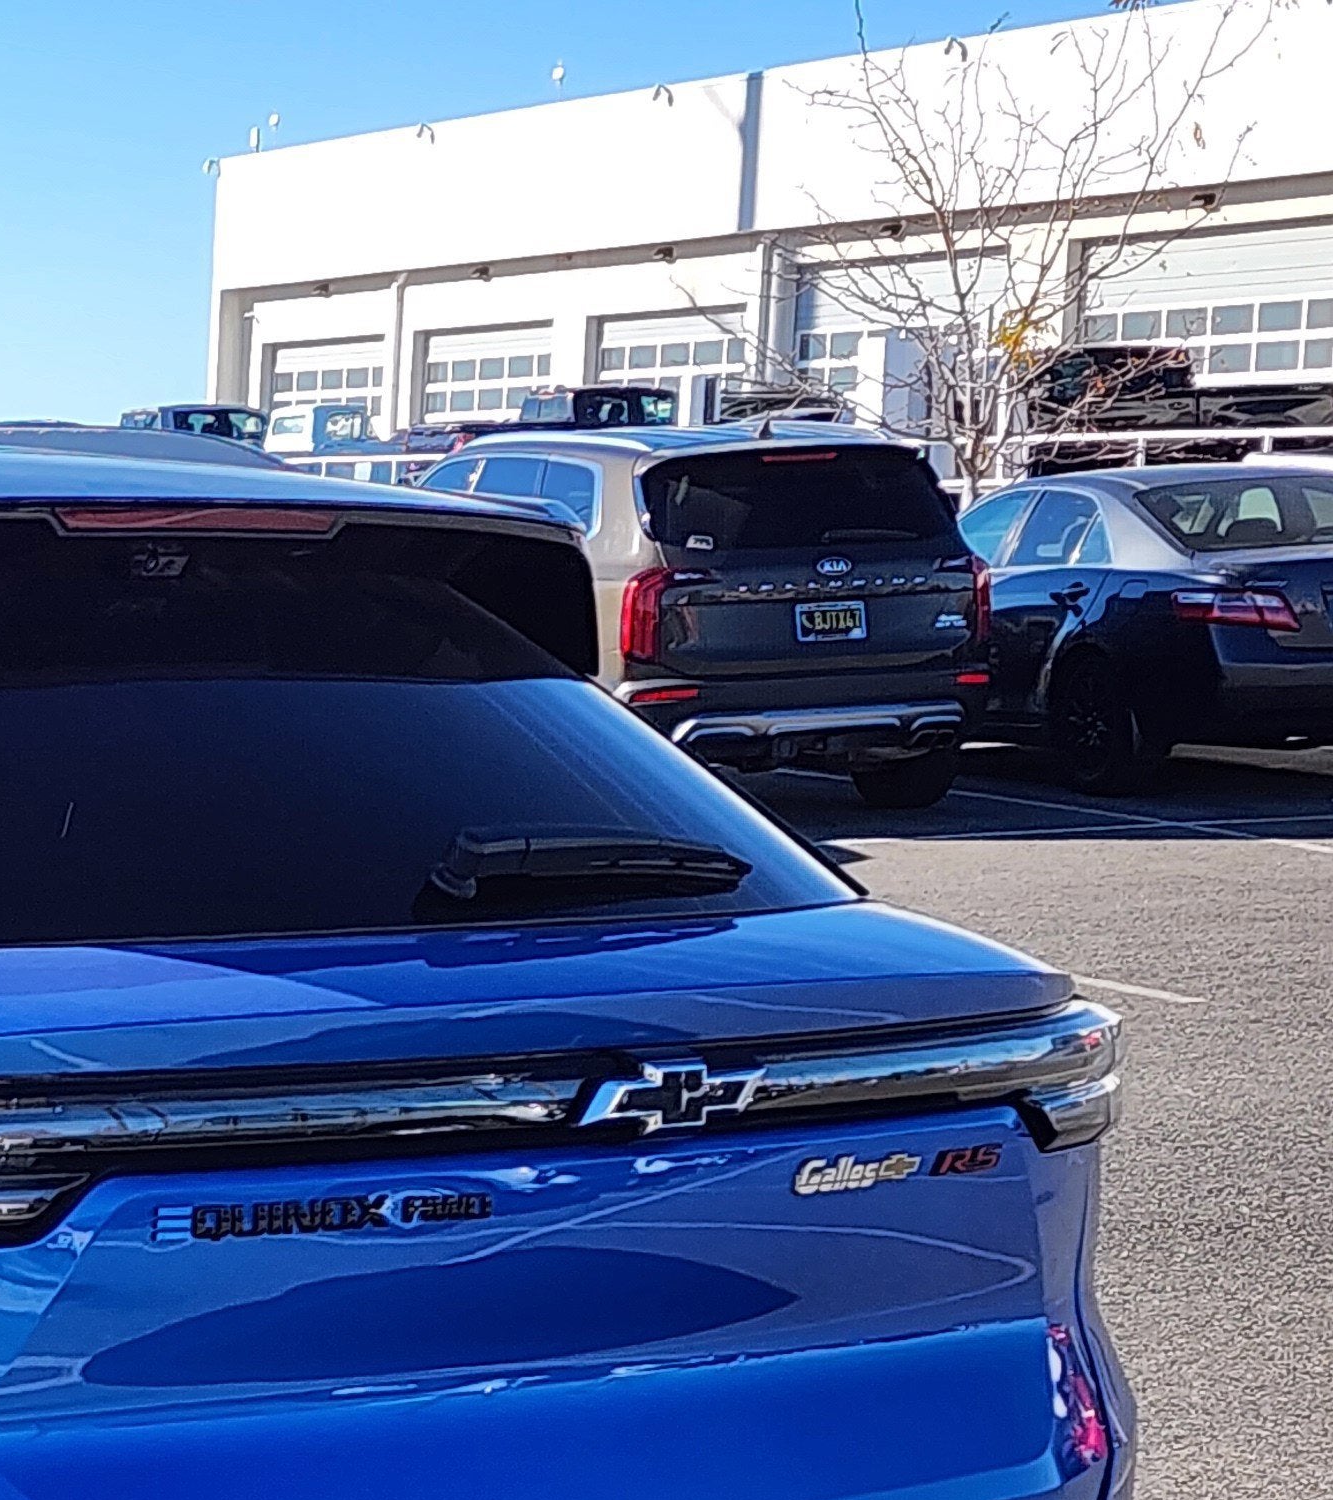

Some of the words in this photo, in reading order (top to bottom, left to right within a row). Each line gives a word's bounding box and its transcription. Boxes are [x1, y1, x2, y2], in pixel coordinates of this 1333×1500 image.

[822, 561, 847, 572] KIA
[929, 1143, 1002, 1176] RS
[150, 1193, 391, 1242] EQUINOX
